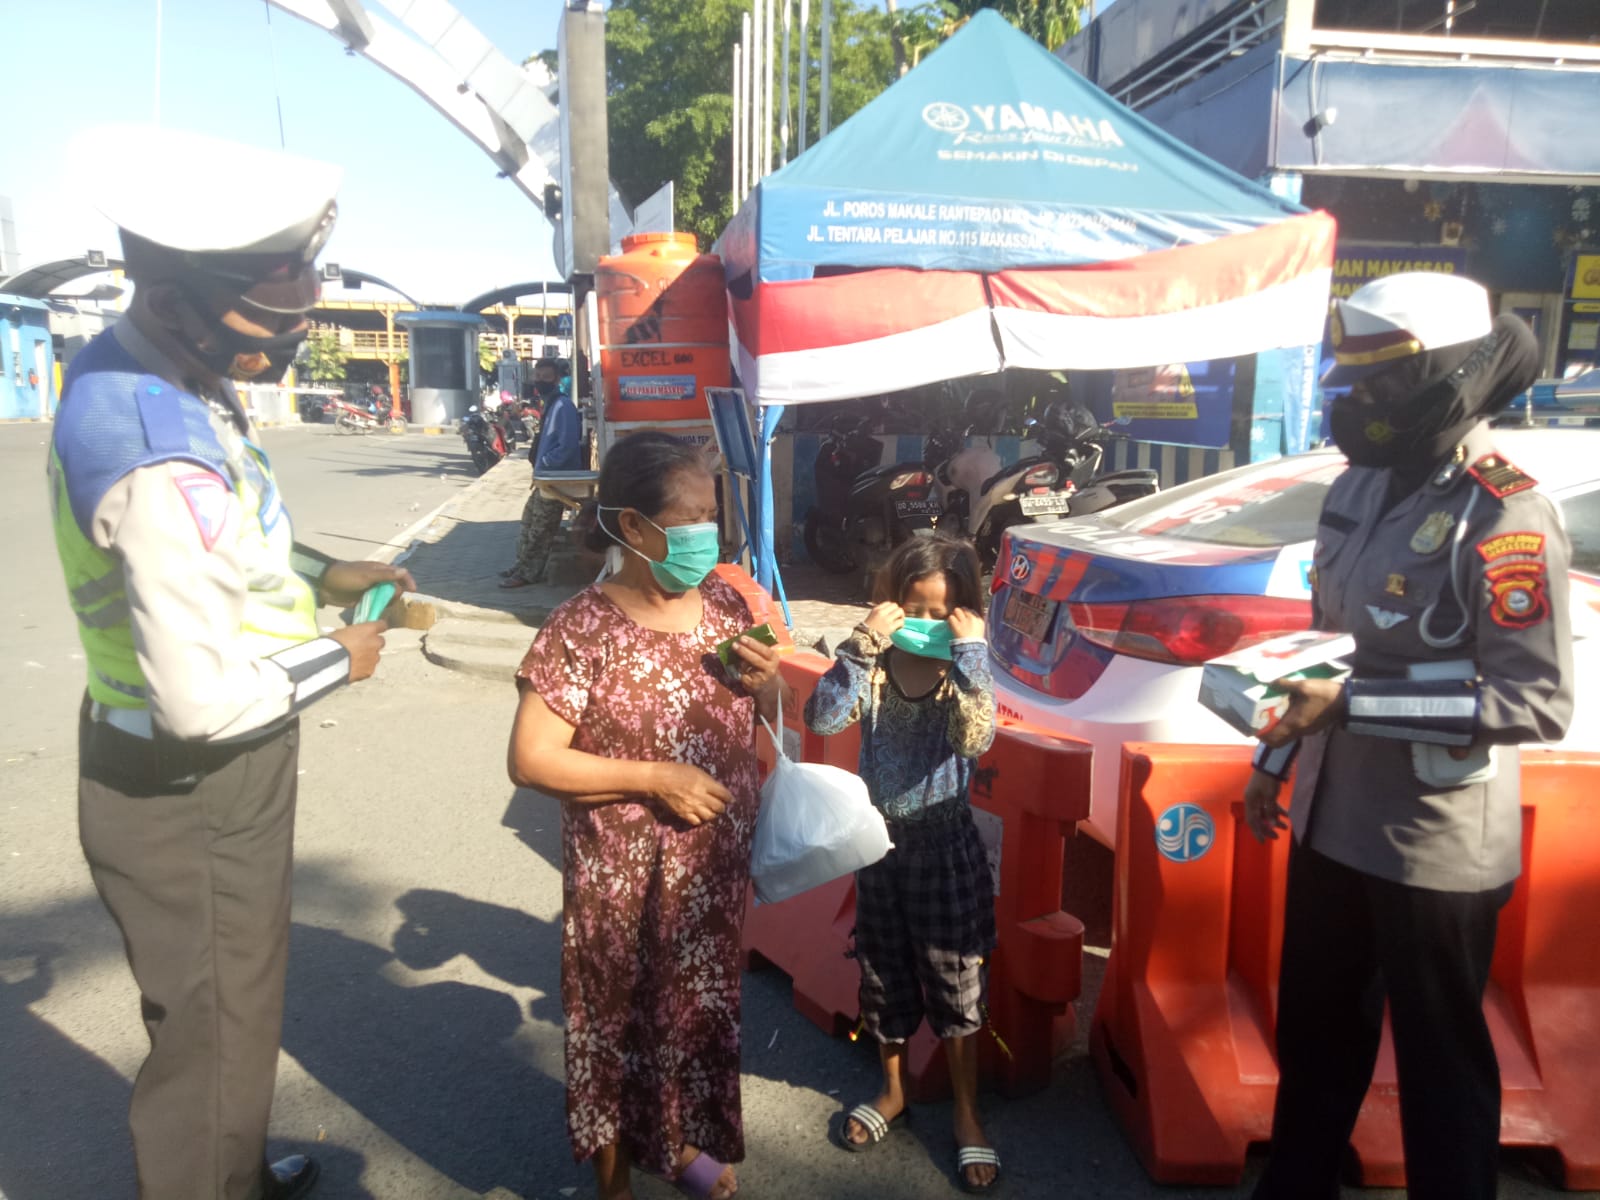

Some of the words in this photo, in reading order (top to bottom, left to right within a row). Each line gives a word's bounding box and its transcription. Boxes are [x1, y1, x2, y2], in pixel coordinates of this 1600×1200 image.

[971, 101, 1125, 147] YAMAHA
[937, 149, 1039, 161] SEMAKIN
[822, 200, 841, 218] JL.
[843, 201, 886, 219] POROS
[887, 202, 938, 220] MAKALE
[938, 205, 1001, 224] RANTEPAO
[806, 224, 825, 242] JL.
[826, 225, 882, 243] TENTARA
[883, 227, 937, 245] PELAJAR
[938, 229, 977, 247] NO.115
[621, 351, 672, 368] EXCEL
[1022, 520, 1198, 562] POLISI
